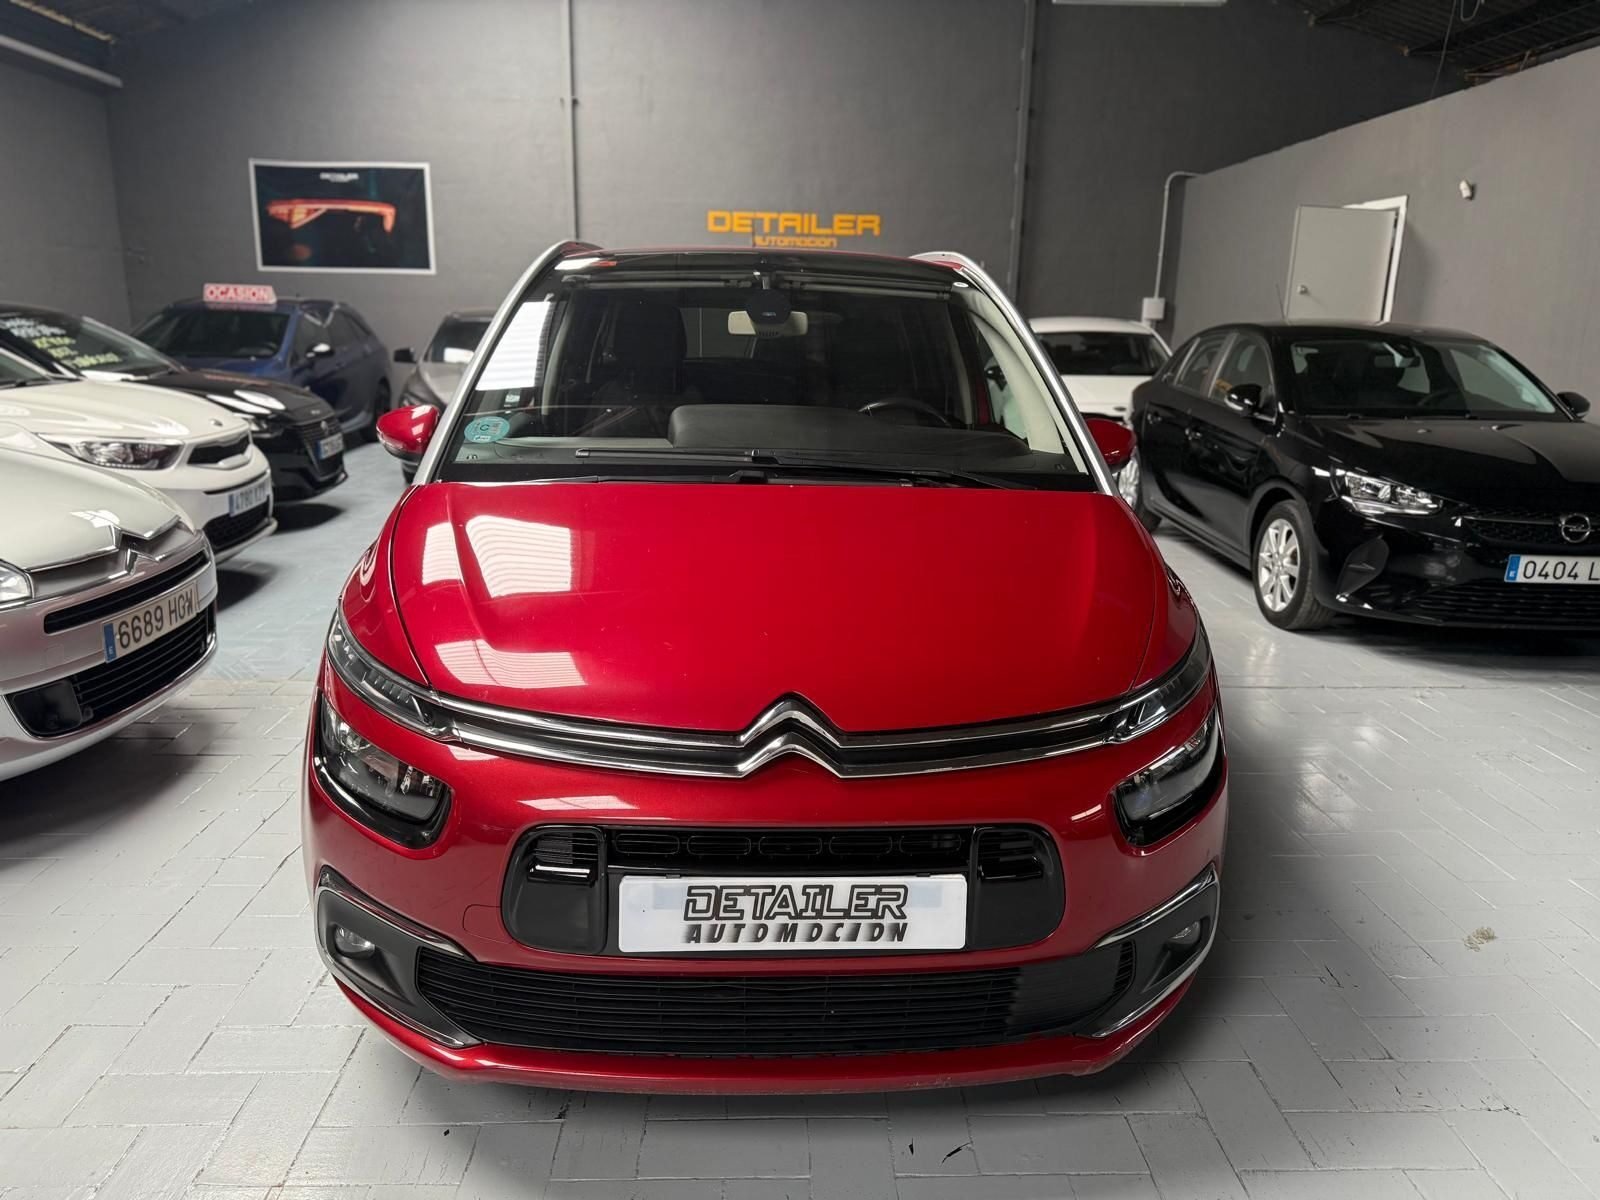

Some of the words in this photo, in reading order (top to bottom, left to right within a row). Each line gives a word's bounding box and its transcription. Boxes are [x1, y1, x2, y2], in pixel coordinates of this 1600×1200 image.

[706, 209, 881, 236] DETAILER
[205, 286, 269, 302] OCASION
[1523, 560, 1579, 580] 0404
[118, 605, 163, 649] 6689
[683, 884, 909, 921] DETAILER
[680, 922, 908, 944] AUTOMOCION
